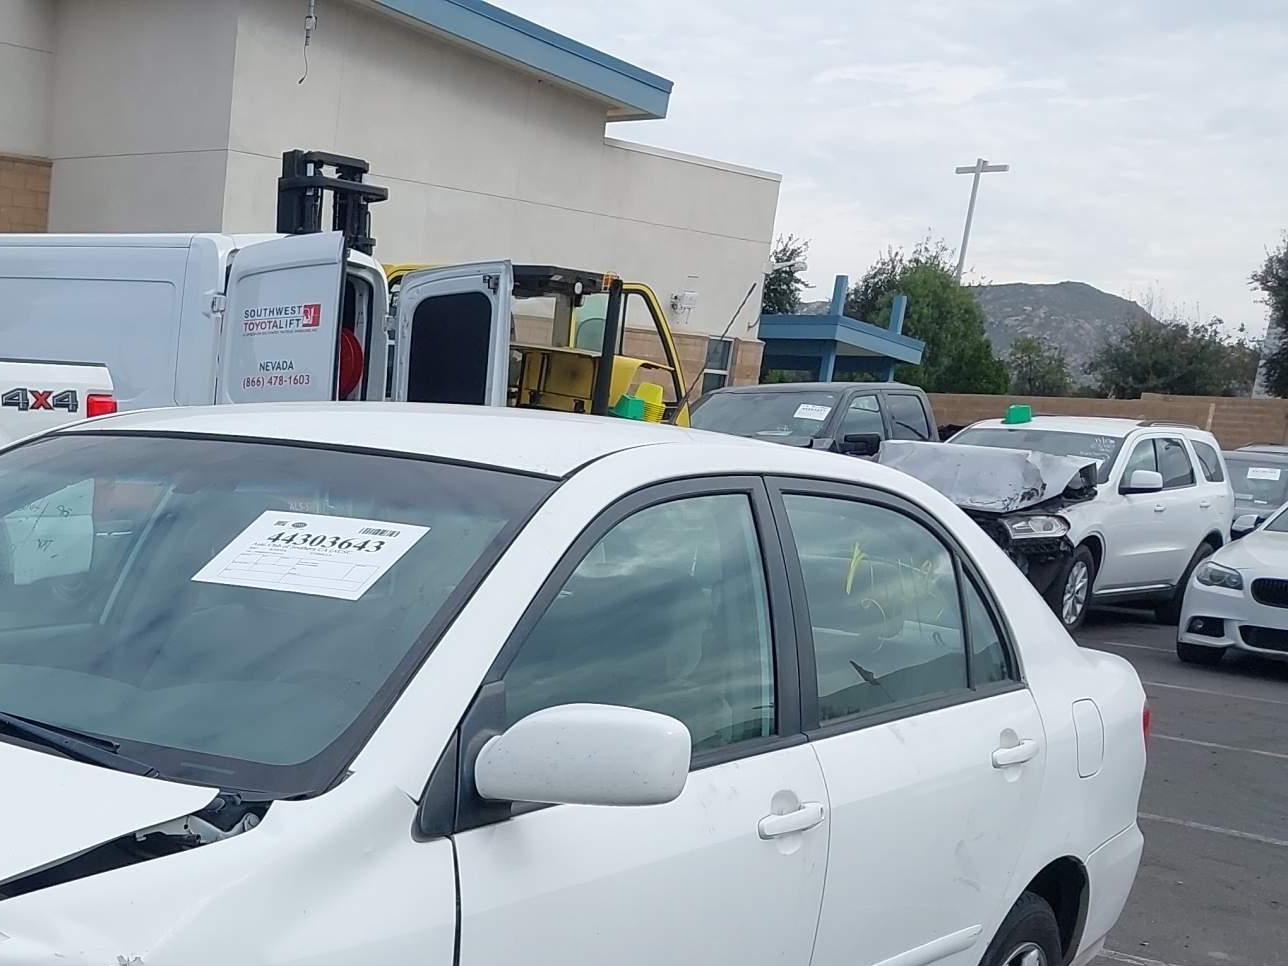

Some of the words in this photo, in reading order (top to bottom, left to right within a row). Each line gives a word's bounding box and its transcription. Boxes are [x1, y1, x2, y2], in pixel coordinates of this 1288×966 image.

[244, 305, 303, 319] SOUTHWEST
[244, 318, 302, 332] TOYOTALIFT
[259, 360, 294, 372] NEVADA
[242, 376, 265, 389] (866)
[267, 374, 310, 386] 478-1603
[267, 531, 386, 554] 44303643
